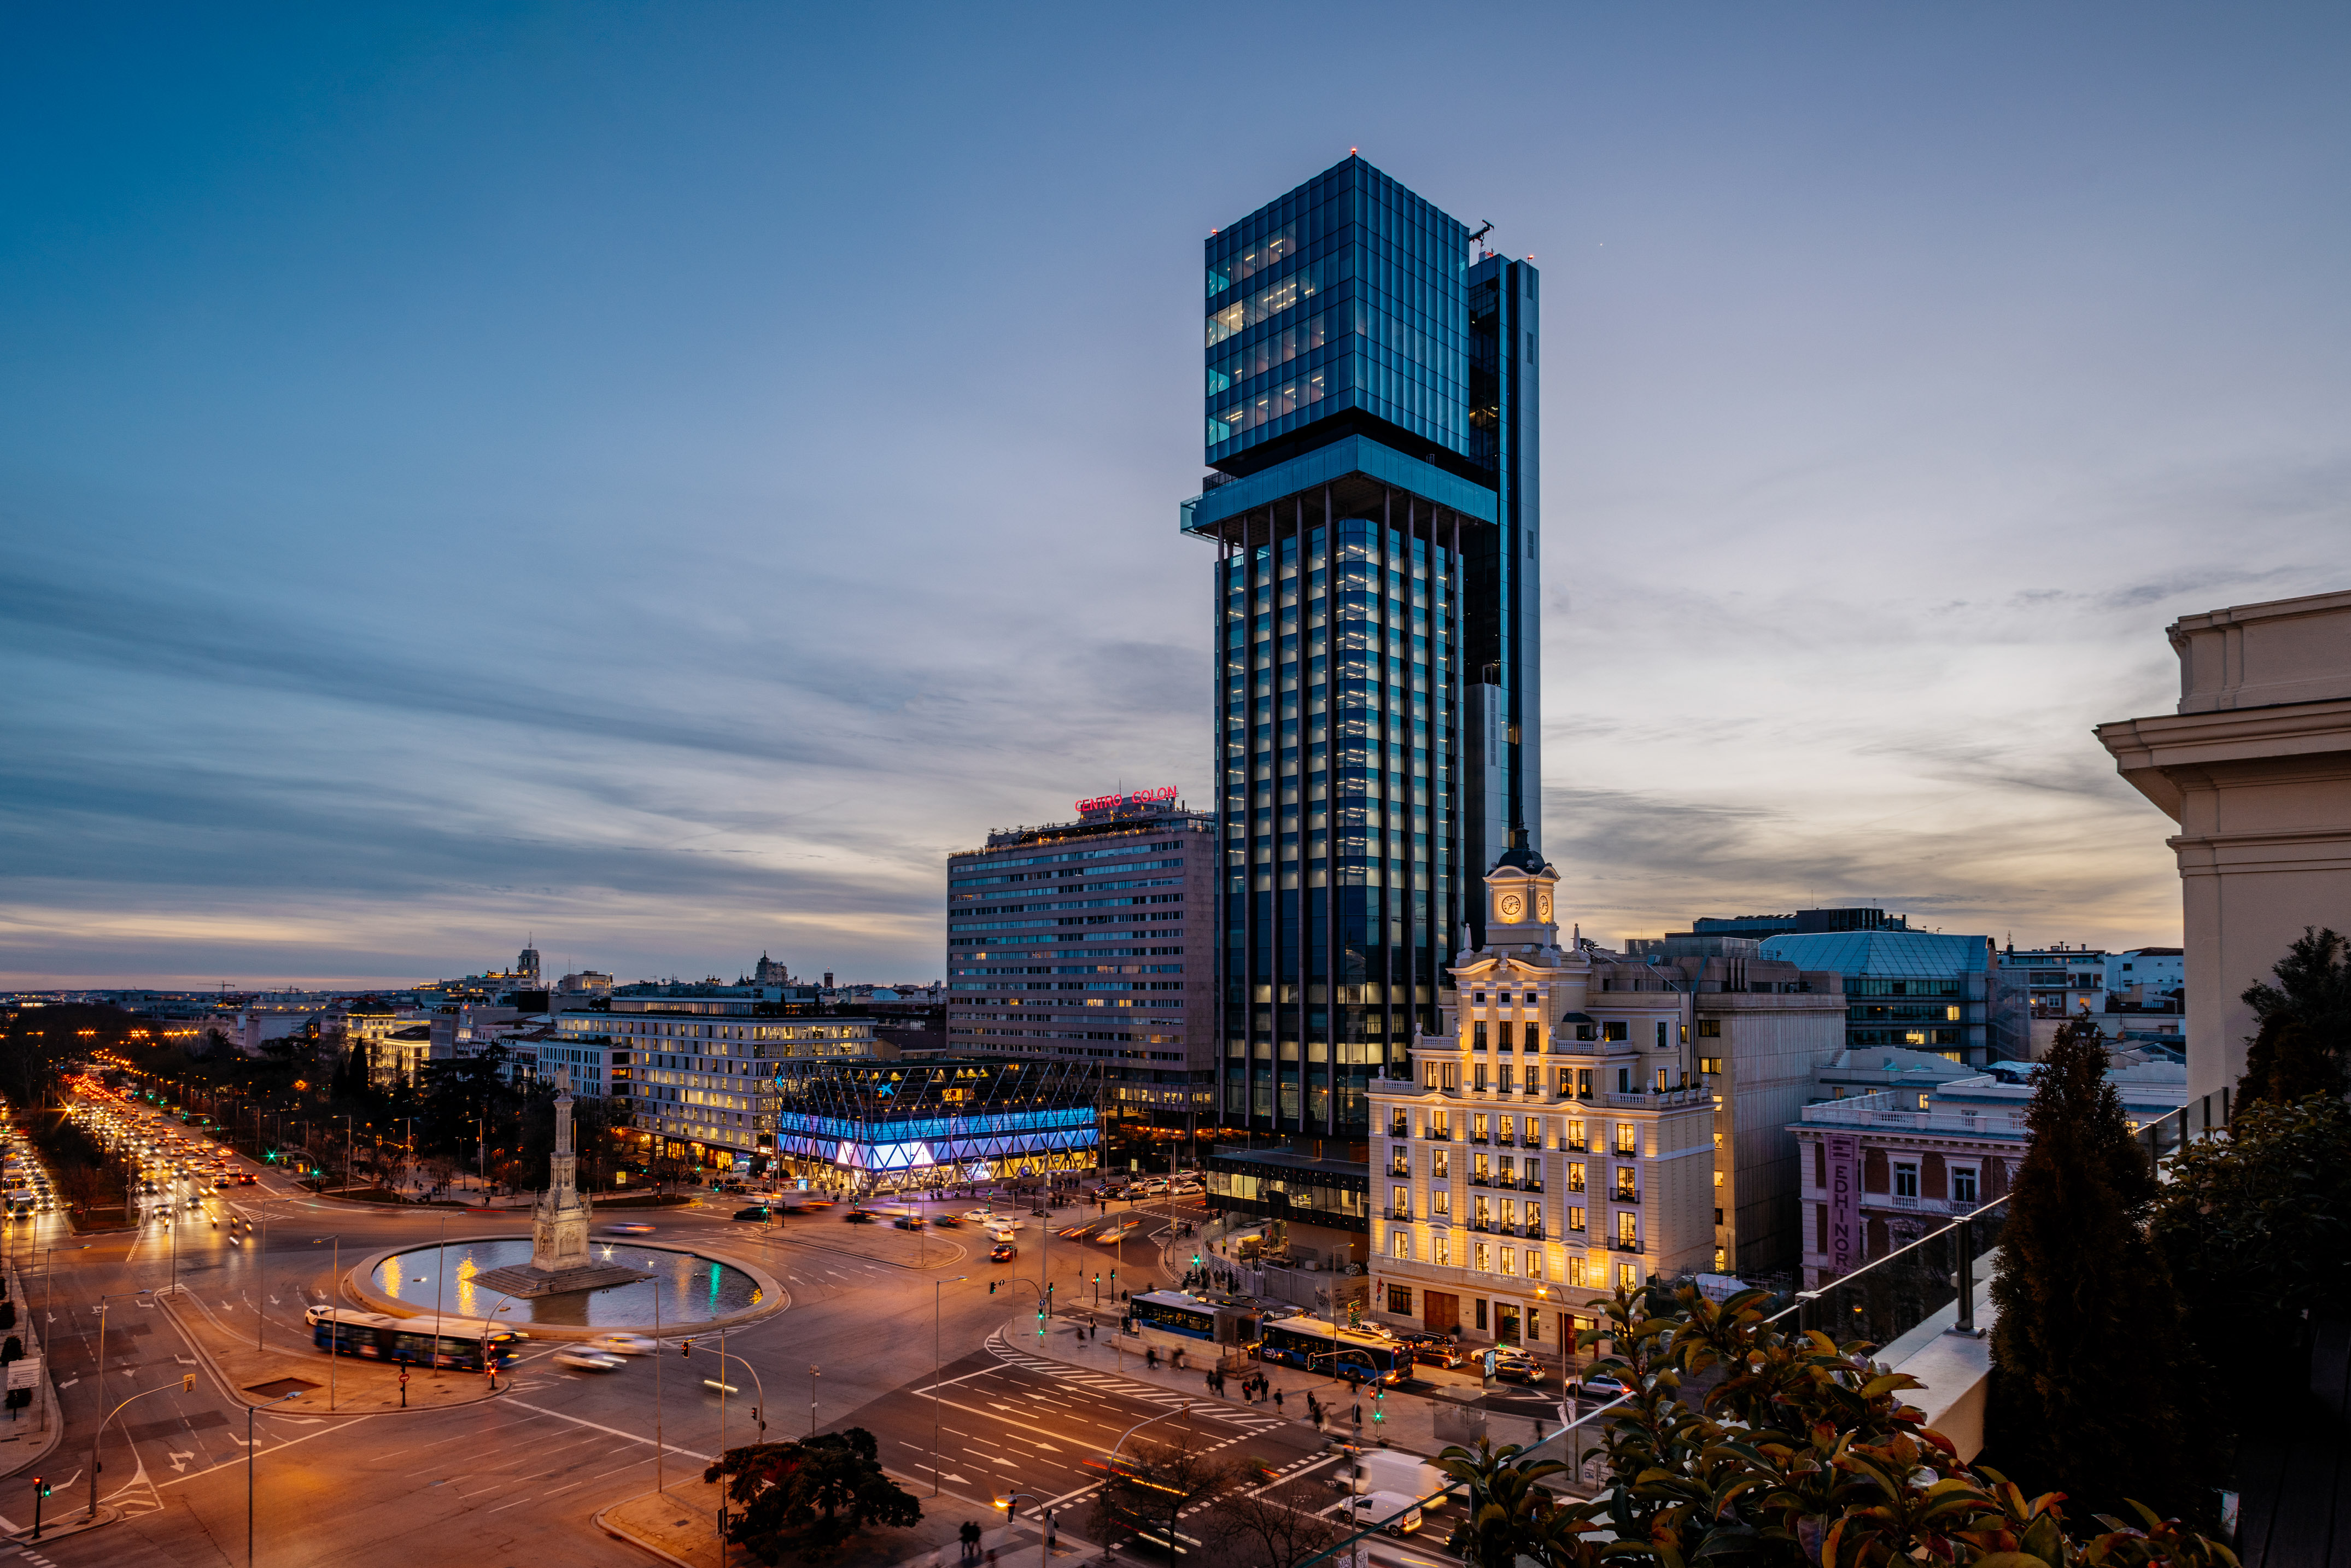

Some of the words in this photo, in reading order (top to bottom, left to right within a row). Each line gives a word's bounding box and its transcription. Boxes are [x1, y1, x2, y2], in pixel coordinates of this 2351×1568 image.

[1075, 794, 1122, 812] CENTRO
[1132, 785, 1177, 804] COLON
[1834, 1165, 1849, 1267] EDHINOR
[1357, 1552, 1367, 1561] CUL
[1338, 1557, 1352, 1568] MAD
[1359, 1559, 1366, 1567] TU
